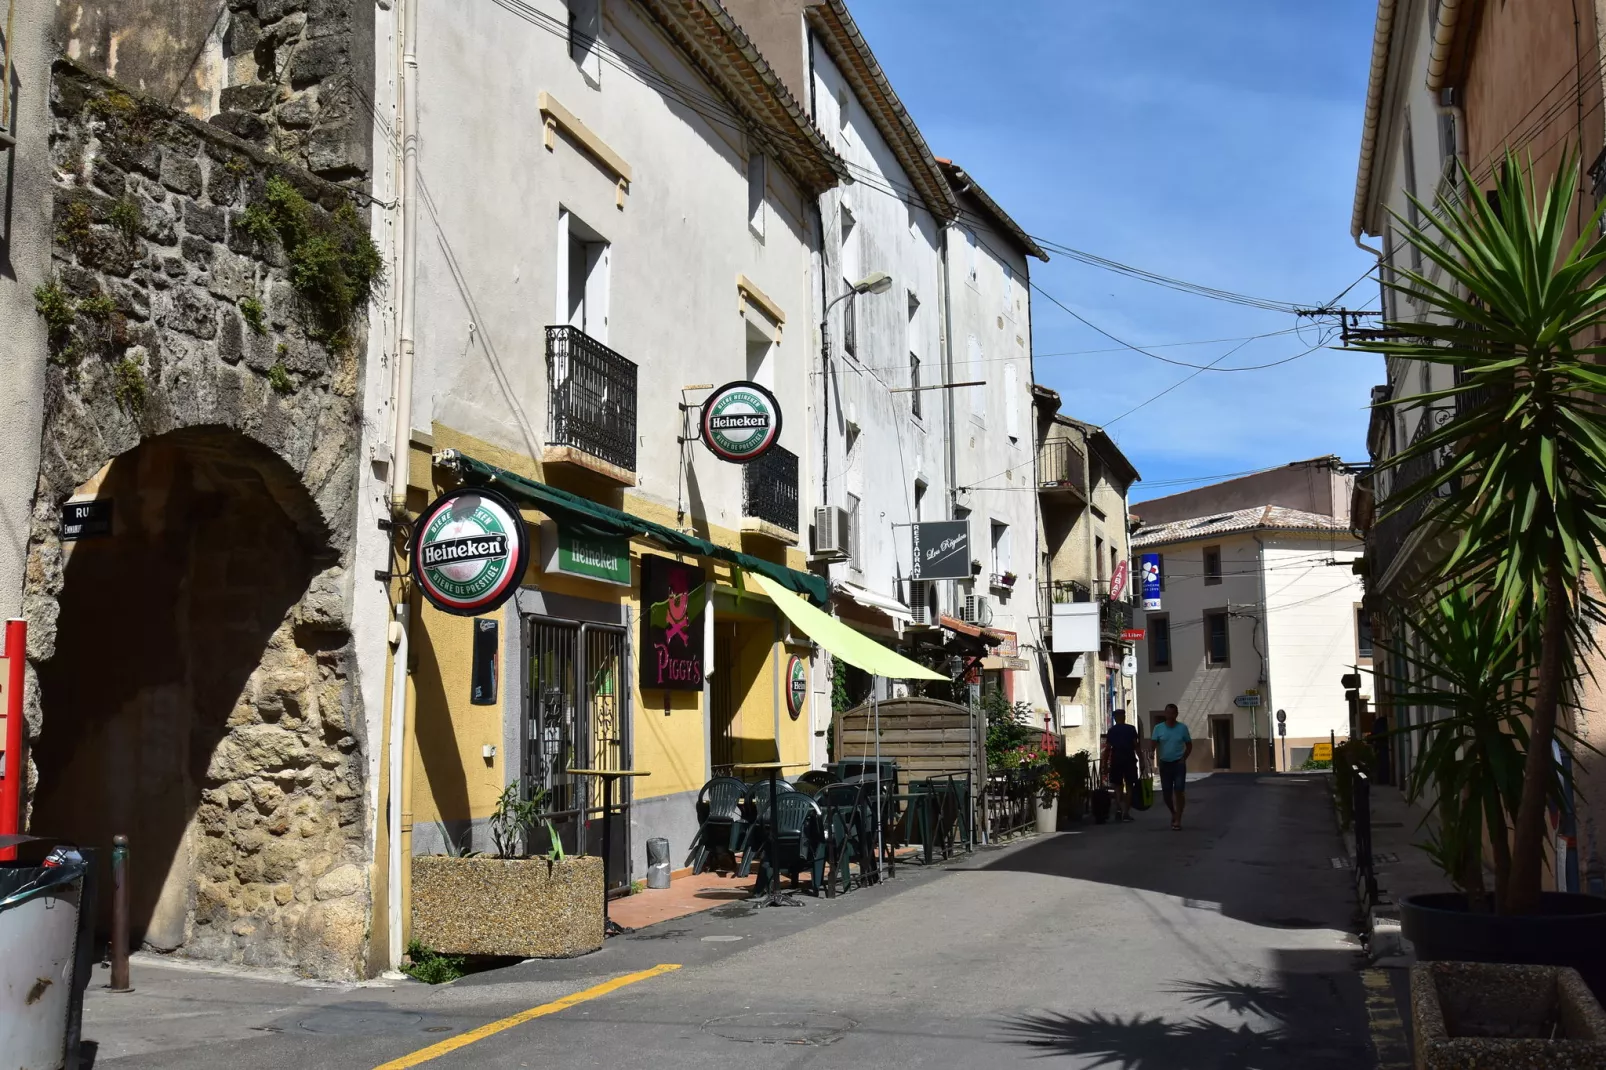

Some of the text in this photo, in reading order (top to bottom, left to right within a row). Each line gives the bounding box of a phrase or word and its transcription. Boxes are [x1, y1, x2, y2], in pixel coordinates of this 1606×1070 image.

[712, 416, 766, 428] Heineken
[76, 507, 92, 518] RU
[431, 512, 451, 533] BIERE
[425, 540, 502, 563] Heineken
[571, 539, 618, 571] Heineken
[433, 565, 499, 594] BIERE DE PRESTIGE
[1111, 565, 1124, 596] TABAC
